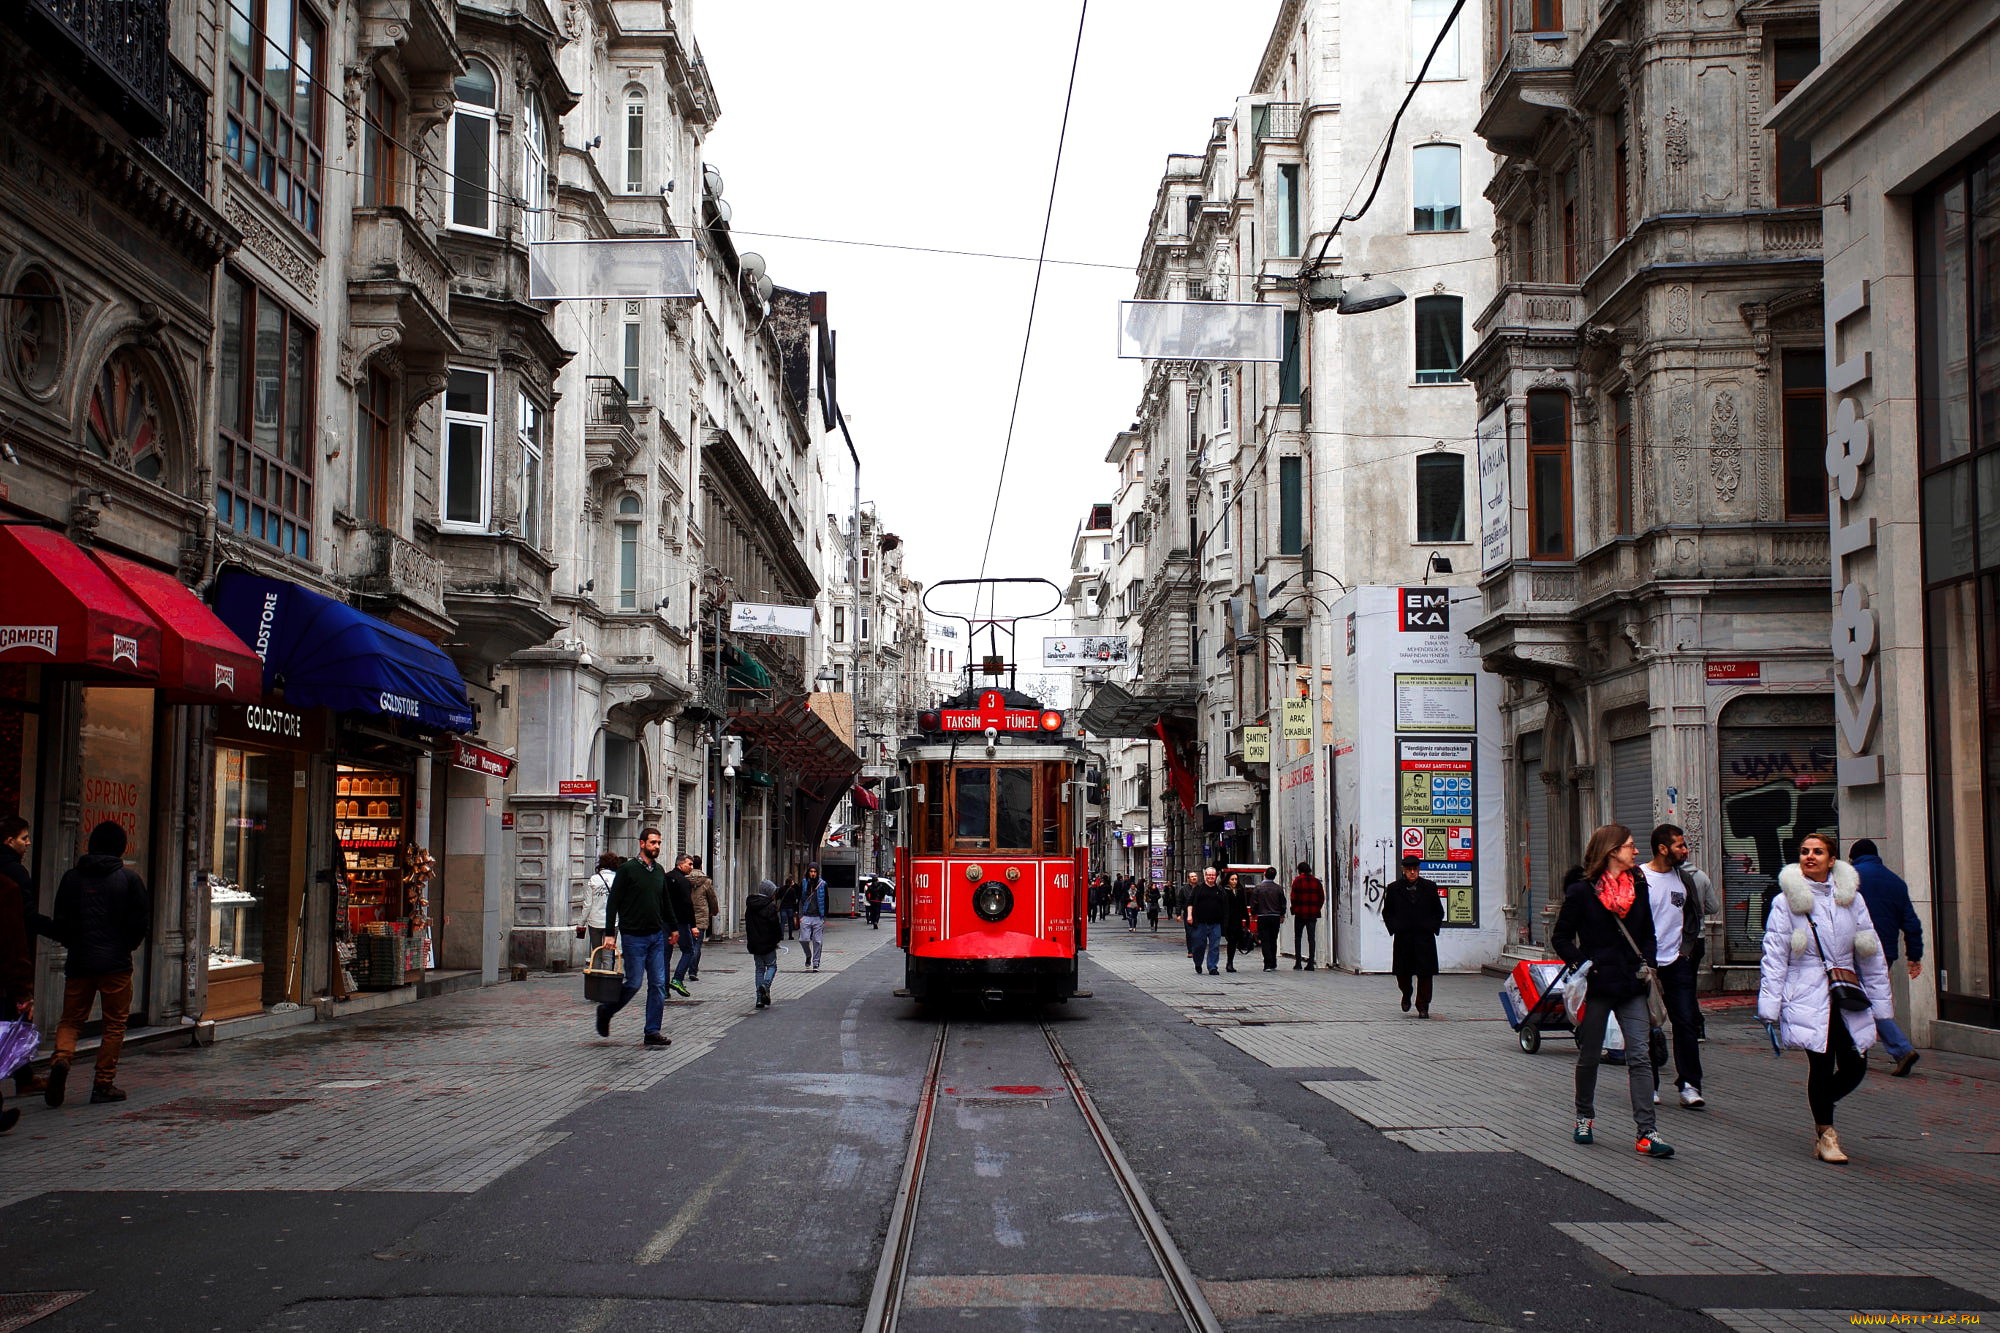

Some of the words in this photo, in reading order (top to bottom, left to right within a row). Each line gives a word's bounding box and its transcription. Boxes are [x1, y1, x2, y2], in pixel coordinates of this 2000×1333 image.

[1407, 595, 1445, 608] EM
[1407, 612, 1445, 625] KA
[0, 629, 54, 649] CAMPER
[256, 592, 278, 671] LDSTORE
[115, 637, 137, 661] CAMPER
[1708, 664, 1737, 672] BALYOZ
[217, 667, 233, 687] CAMPER
[380, 691, 420, 717] GOLDSTORE
[987, 693, 995, 708] 3
[246, 705, 301, 738] GOLDSTORE
[1004, 714, 1039, 729] TÜNEL
[1289, 714, 1306, 724] ARAÇ
[1284, 726, 1312, 737] ÇIKABİLİR
[1249, 747, 1265, 758] ÇIKIŞI
[86, 779, 138, 807] SPRING
[915, 874, 929, 888] 410
[1054, 874, 1069, 888] 410
